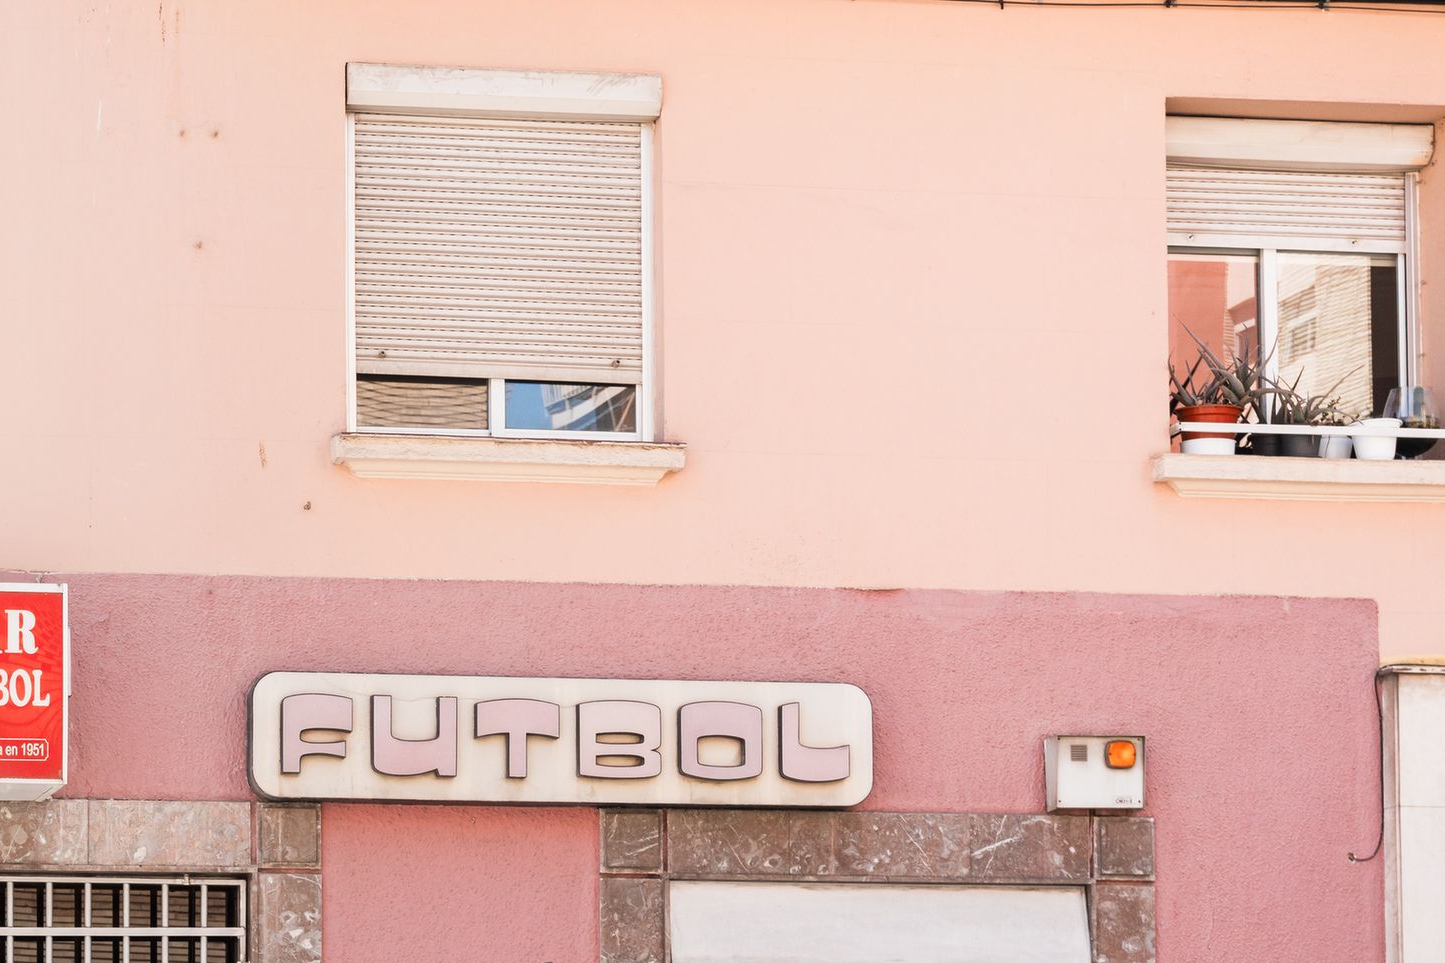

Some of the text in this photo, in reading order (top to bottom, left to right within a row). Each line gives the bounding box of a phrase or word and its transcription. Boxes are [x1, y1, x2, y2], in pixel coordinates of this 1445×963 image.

[5, 745, 18, 756] en
[21, 742, 45, 757] 1951
[280, 692, 851, 783] FUTBOL
